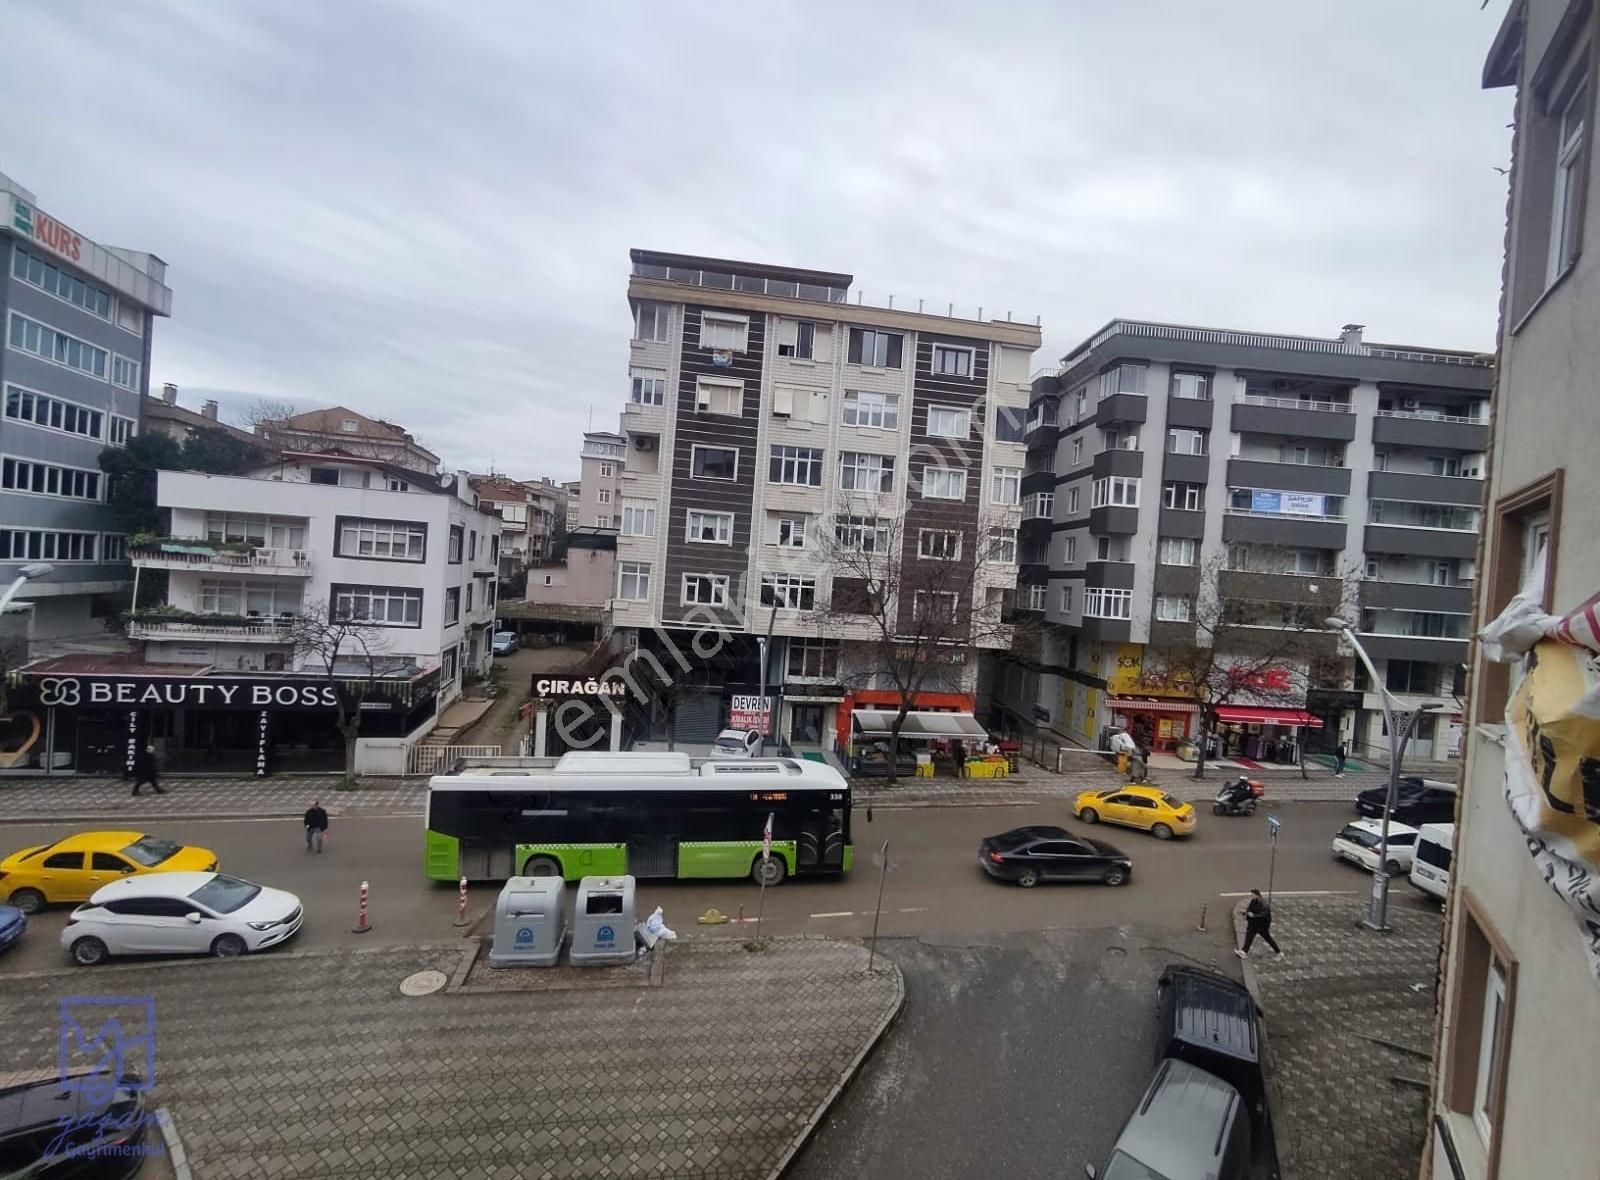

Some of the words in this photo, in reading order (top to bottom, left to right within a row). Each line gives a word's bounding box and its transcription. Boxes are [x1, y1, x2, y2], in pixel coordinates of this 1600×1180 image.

[36, 213, 81, 261] KURS
[90, 682, 240, 704] BEAUTY
[251, 685, 338, 706] BOSS
[536, 677, 626, 697] ÇIRAĞAN
[733, 696, 769, 710] DEVREN
